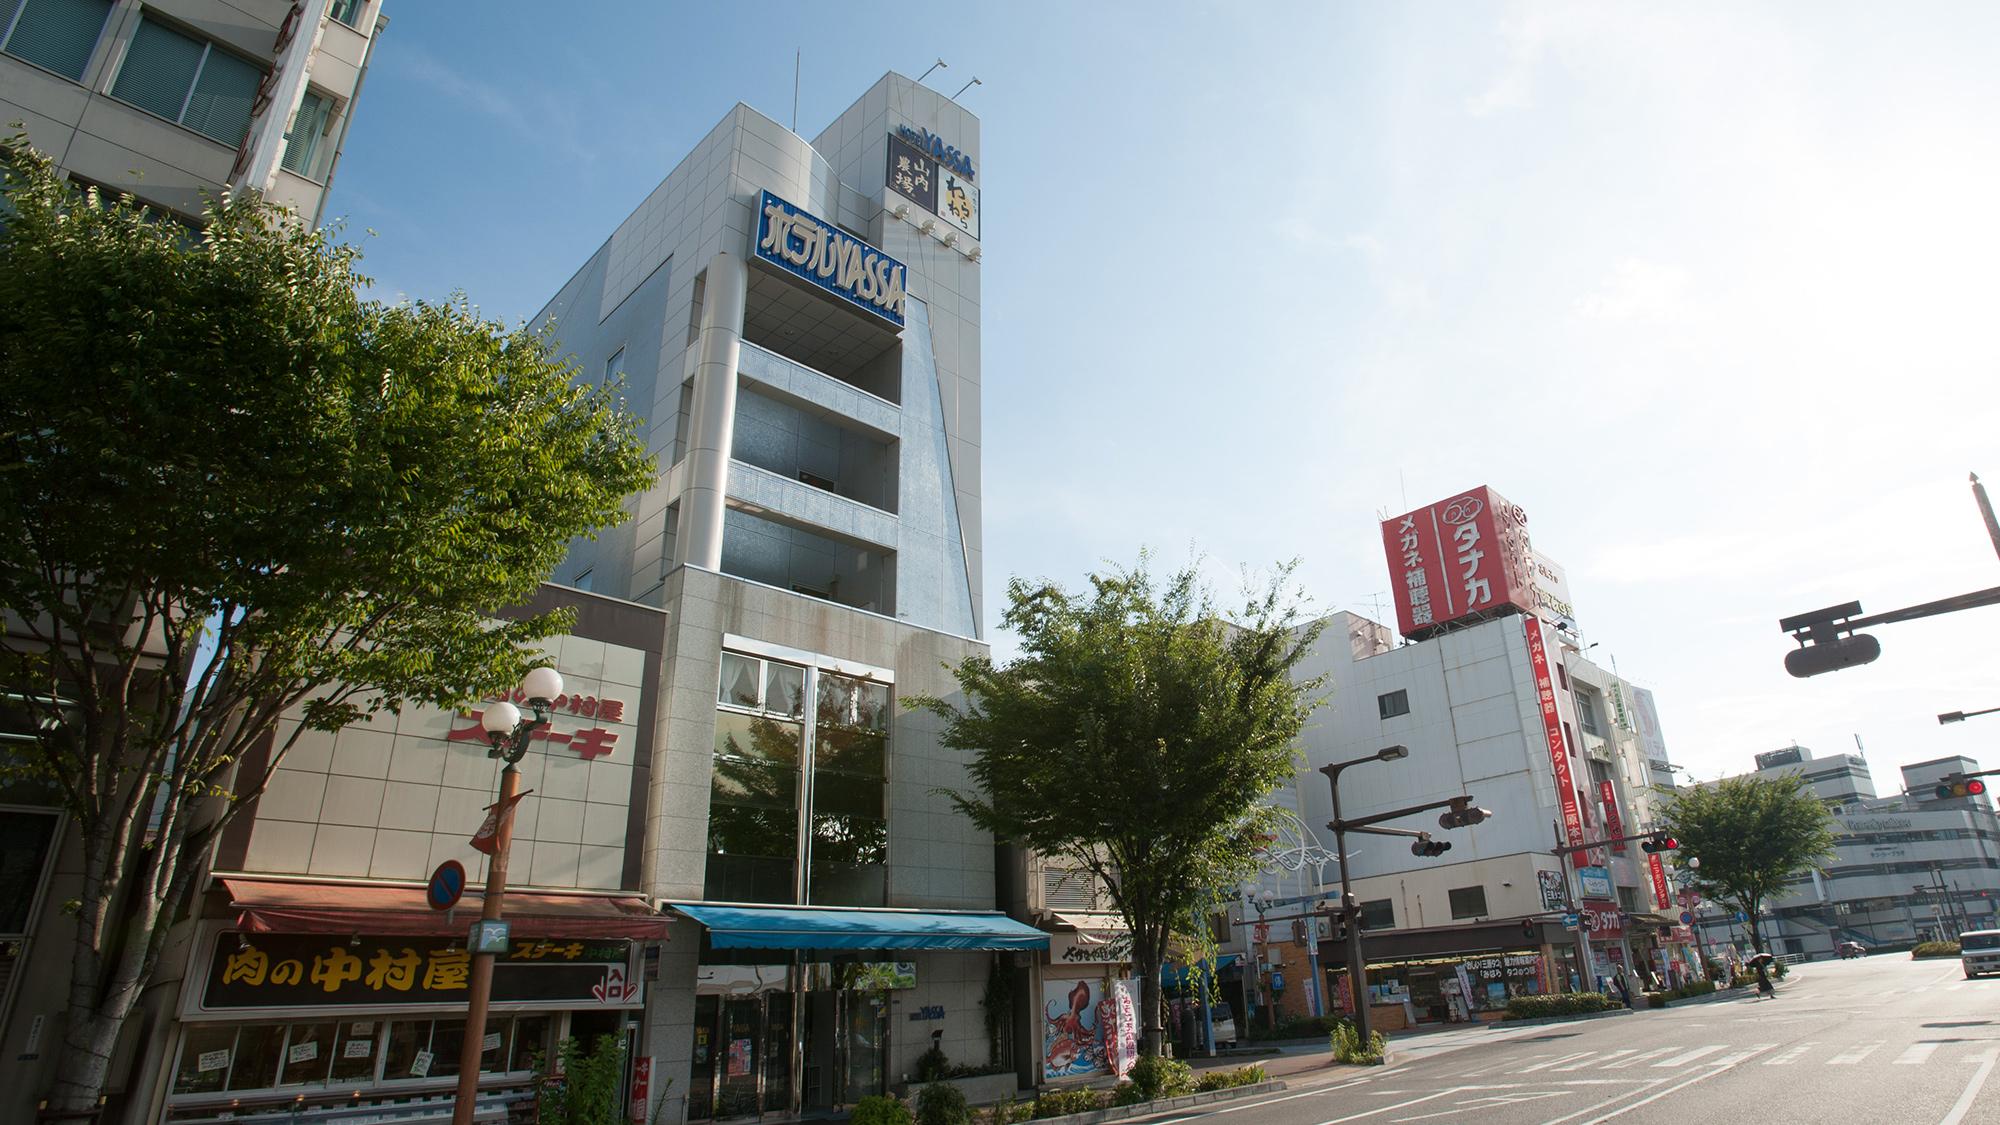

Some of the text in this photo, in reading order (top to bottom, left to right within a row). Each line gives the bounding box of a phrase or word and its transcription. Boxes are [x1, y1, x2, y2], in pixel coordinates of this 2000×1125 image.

[920, 126, 975, 181] YASSA
[914, 158, 930, 193] 山内
[1453, 521, 1493, 612] タナカ
[1530, 629, 1545, 665] メガネ
[1538, 678, 1556, 714] 補聴器
[1549, 727, 1570, 787] コンタクト
[1600, 911, 1620, 930] タナカ
[222, 946, 472, 992] 肉の中村屋
[511, 942, 585, 960] ステーキ
[608, 968, 623, 998] 入口
